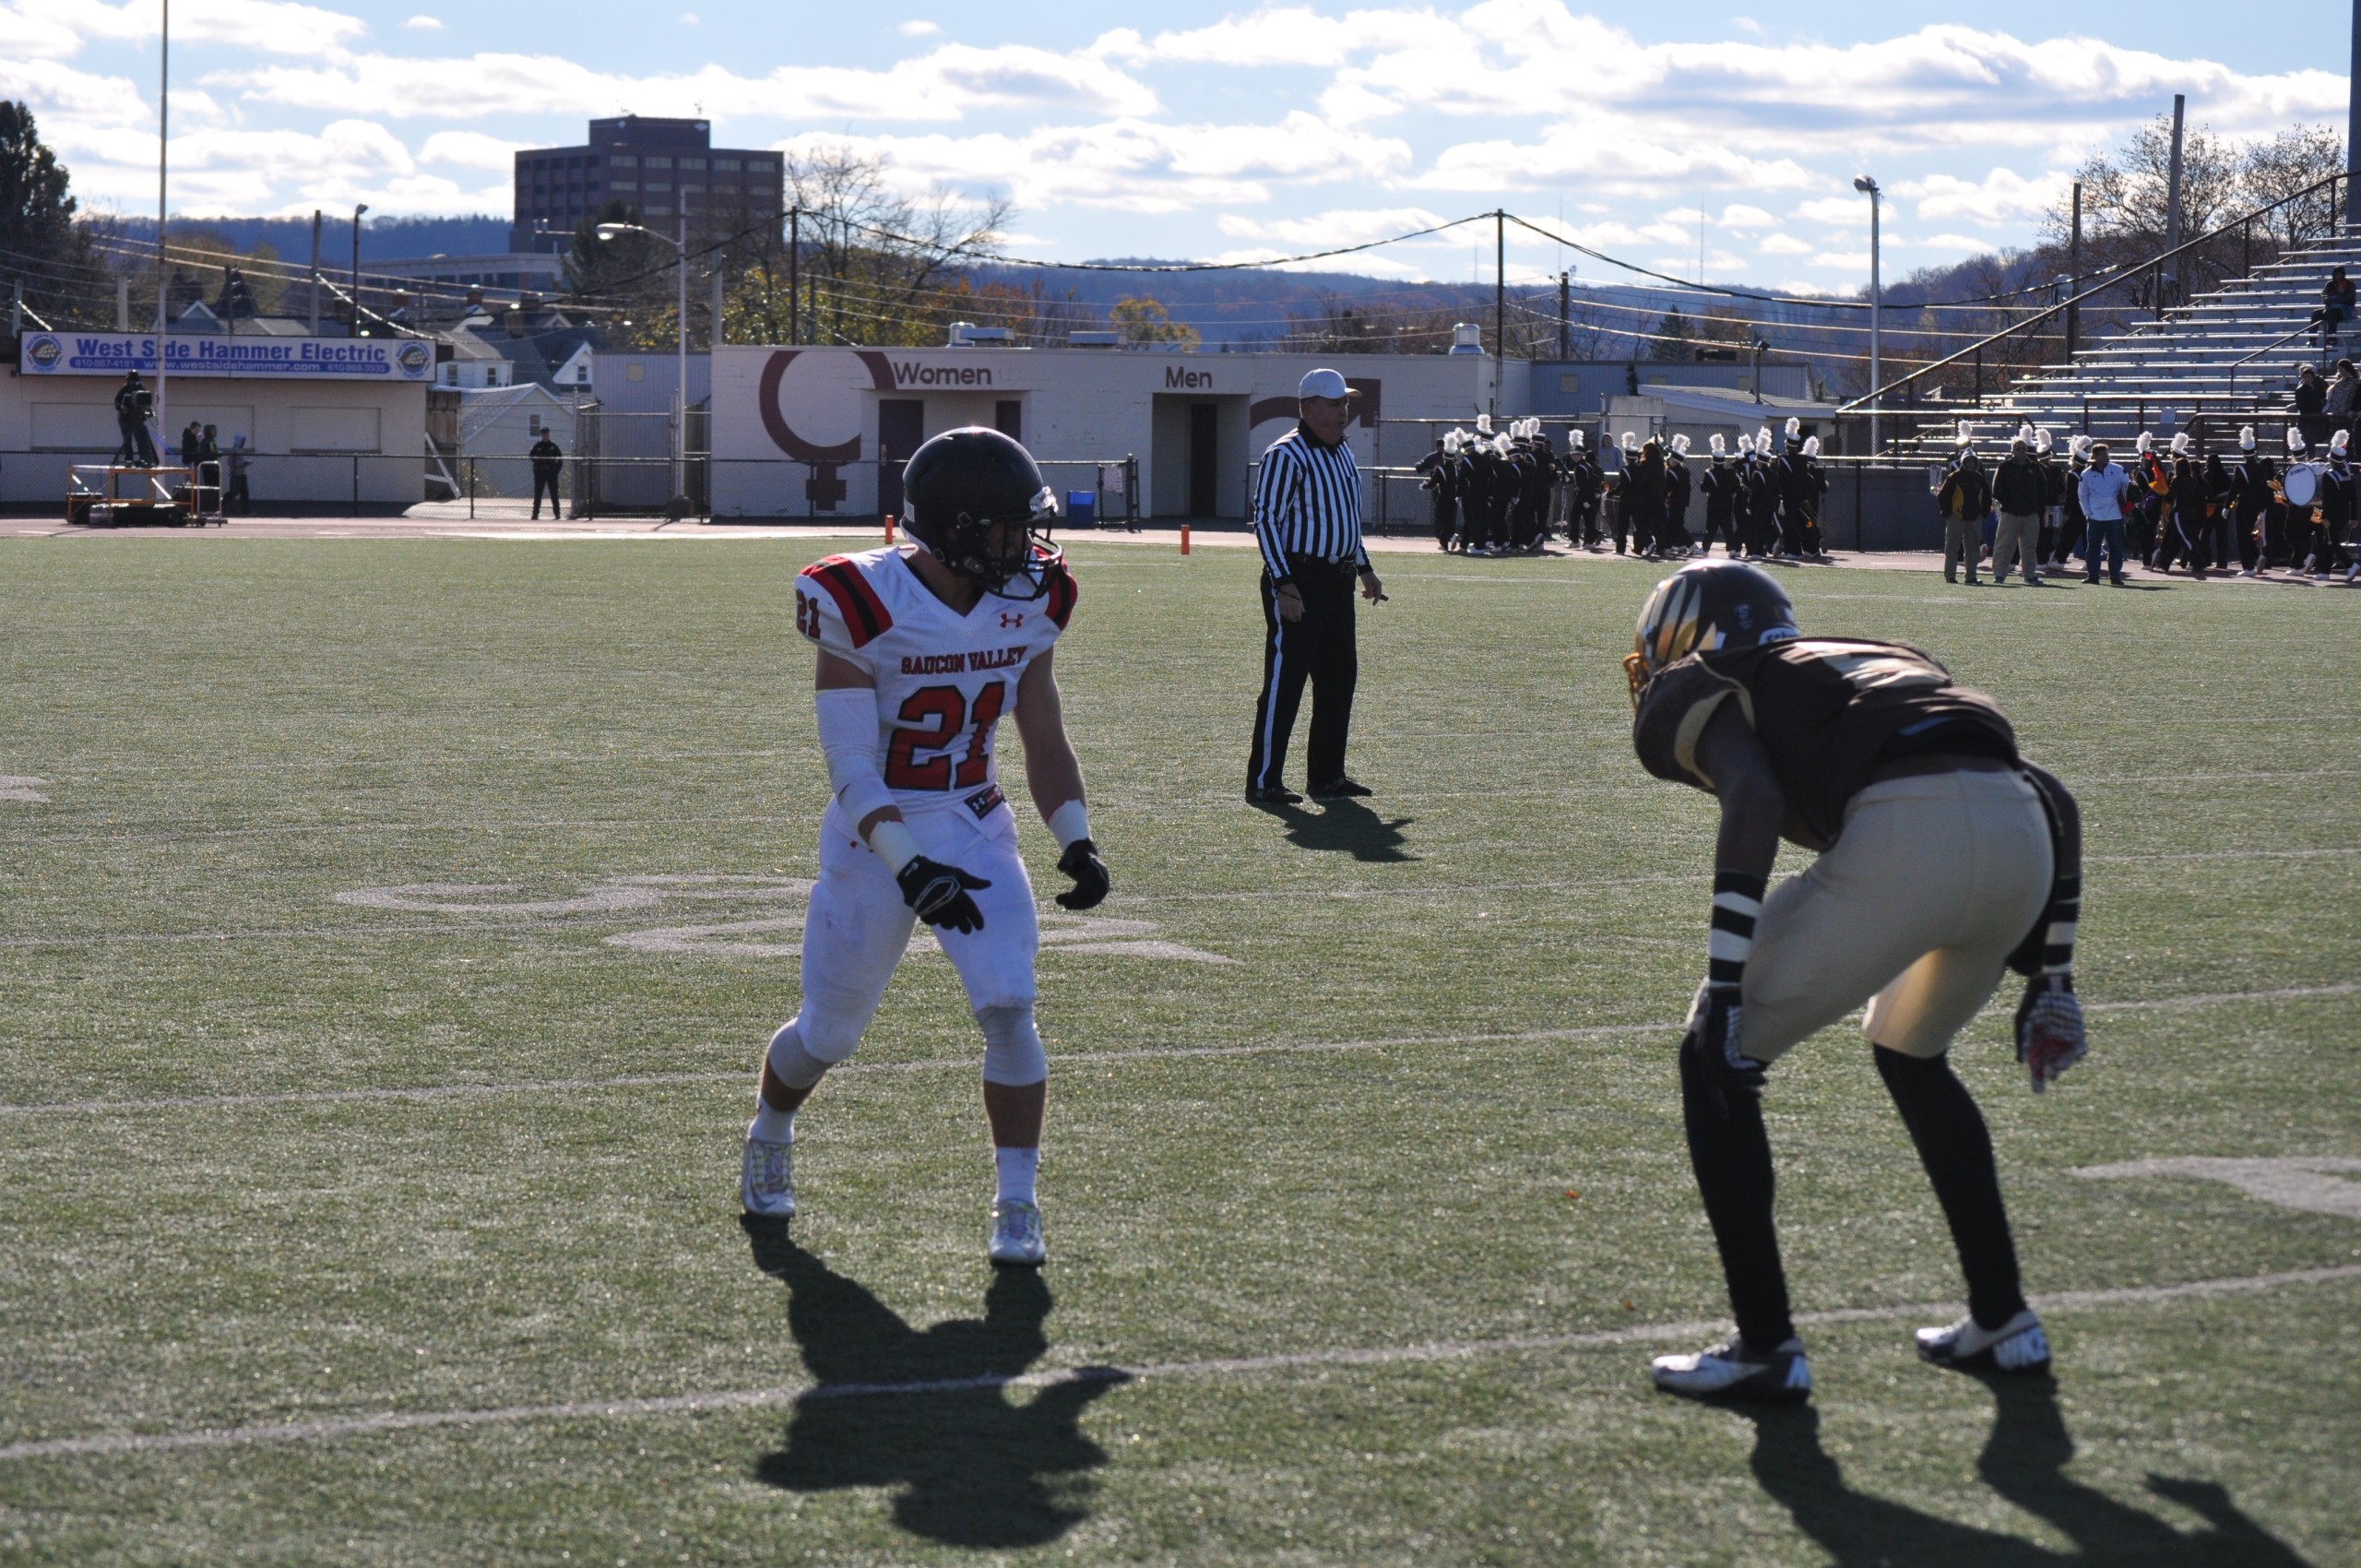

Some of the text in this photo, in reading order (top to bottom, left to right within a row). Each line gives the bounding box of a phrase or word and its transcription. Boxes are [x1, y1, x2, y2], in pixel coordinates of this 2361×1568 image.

[76, 339, 134, 357] West
[141, 339, 190, 358] Sde
[199, 340, 292, 359] Hammer
[301, 343, 386, 361] Electric
[893, 362, 991, 385] Women
[1166, 365, 1213, 388] Men
[796, 588, 821, 640] 21
[901, 646, 1028, 675] SAUCON VALLEY
[884, 681, 1006, 792] 21
